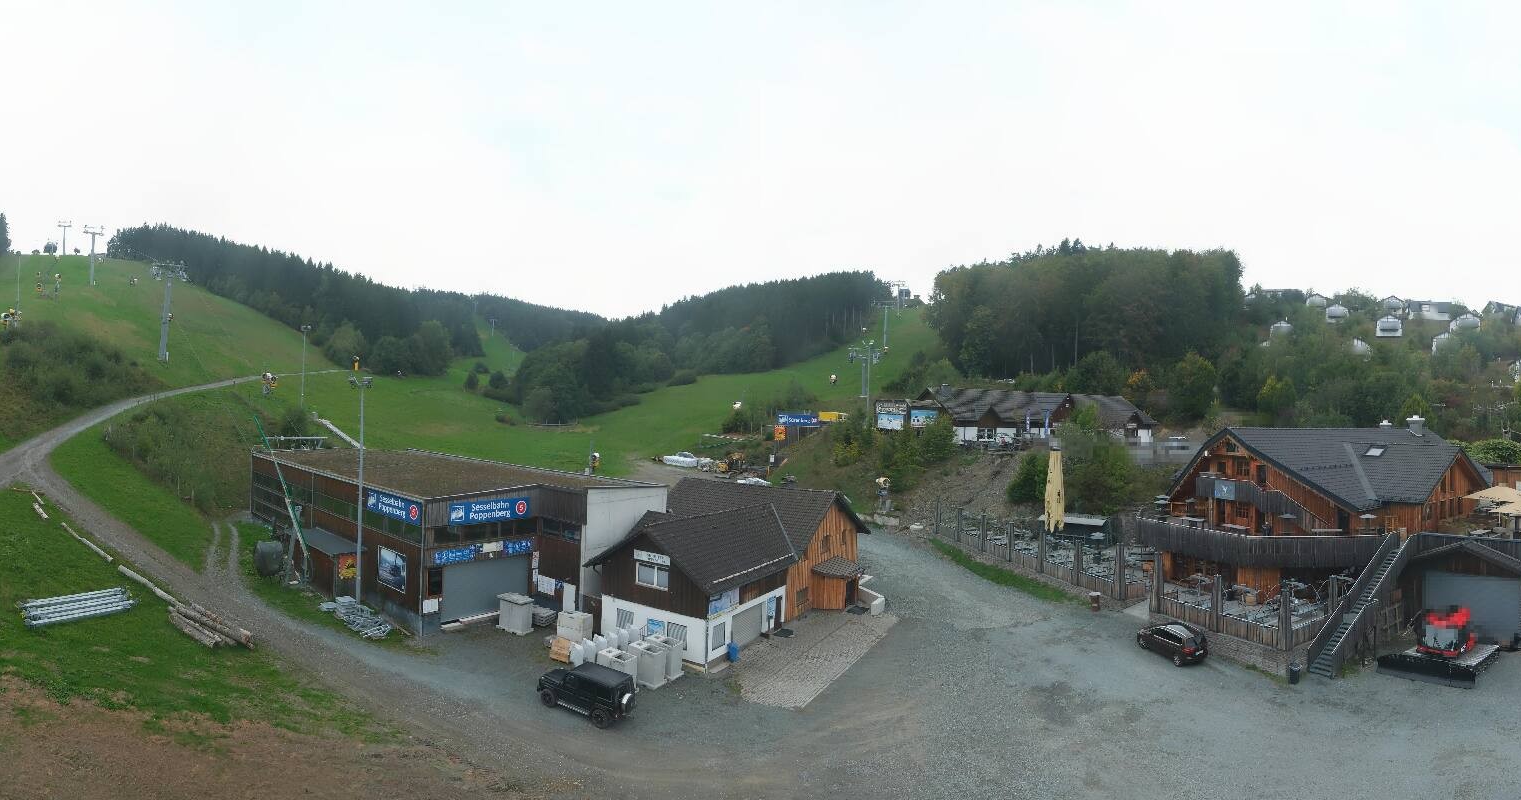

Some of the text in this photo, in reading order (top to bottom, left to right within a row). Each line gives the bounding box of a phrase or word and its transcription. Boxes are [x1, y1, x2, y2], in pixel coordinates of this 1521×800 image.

[379, 495, 405, 508] Sesselbahn
[471, 501, 509, 511] Sesselbahn
[379, 503, 405, 518] Poppenberg
[469, 510, 511, 520] Poppenberg
